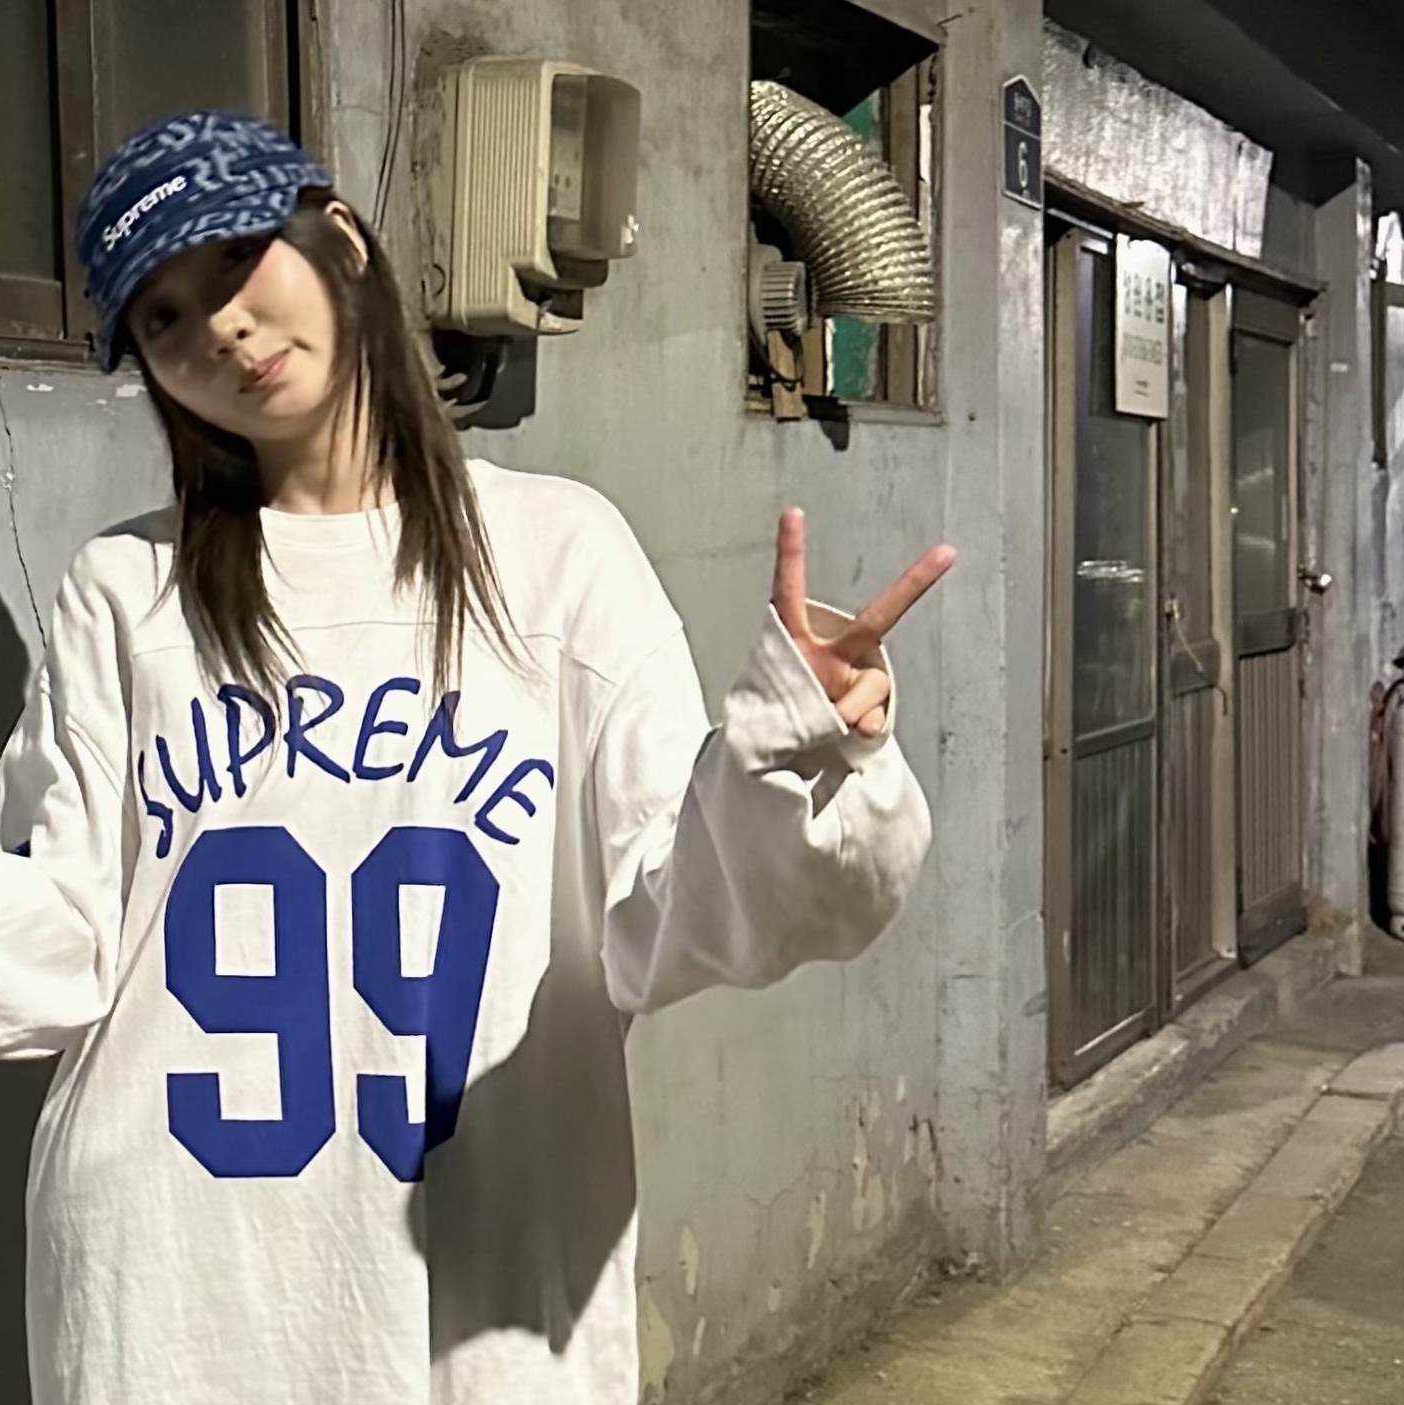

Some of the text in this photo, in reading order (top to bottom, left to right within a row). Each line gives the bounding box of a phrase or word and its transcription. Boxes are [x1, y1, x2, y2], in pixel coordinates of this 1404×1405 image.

[103, 175, 188, 251] Supreme
[1017, 141, 1029, 188] 6
[137, 674, 555, 859] SUPREME
[164, 826, 501, 1183] 99
